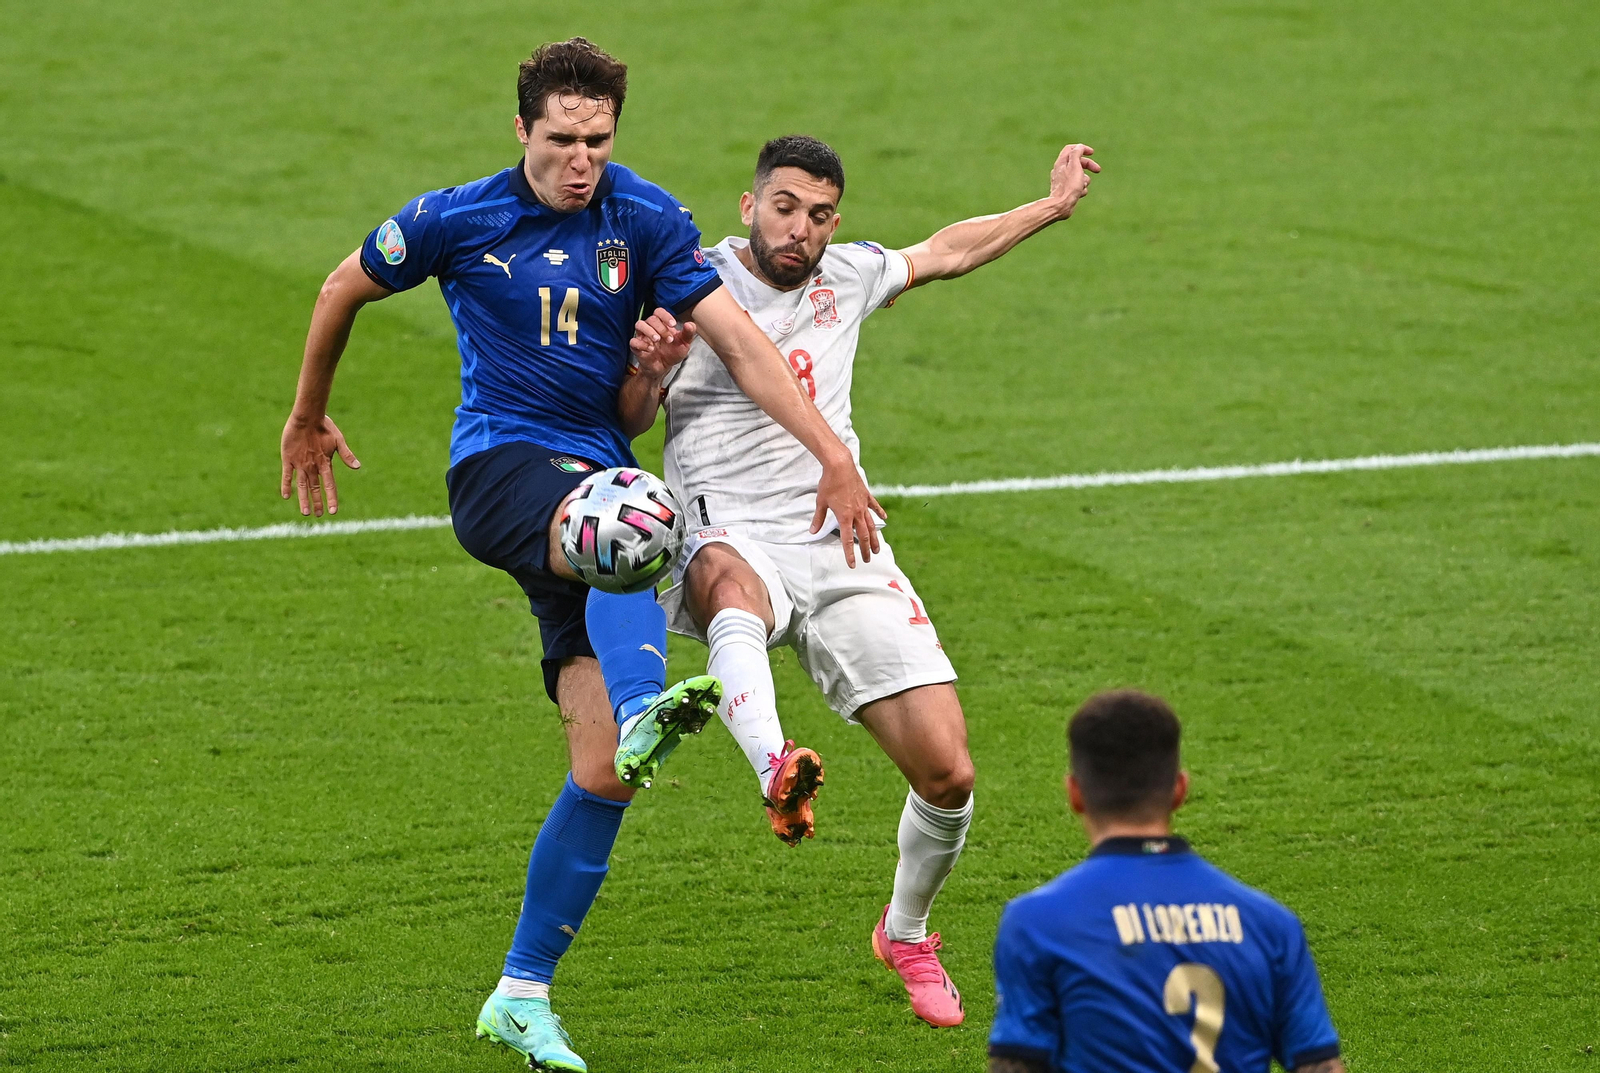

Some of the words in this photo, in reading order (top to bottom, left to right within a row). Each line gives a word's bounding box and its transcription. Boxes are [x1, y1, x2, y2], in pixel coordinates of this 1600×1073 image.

[599, 250, 626, 259] ITALIA
[538, 286, 580, 346] 14
[1112, 903, 1146, 946] DI
[1142, 902, 1244, 945] LORENZO
[1162, 961, 1226, 1073] 2
